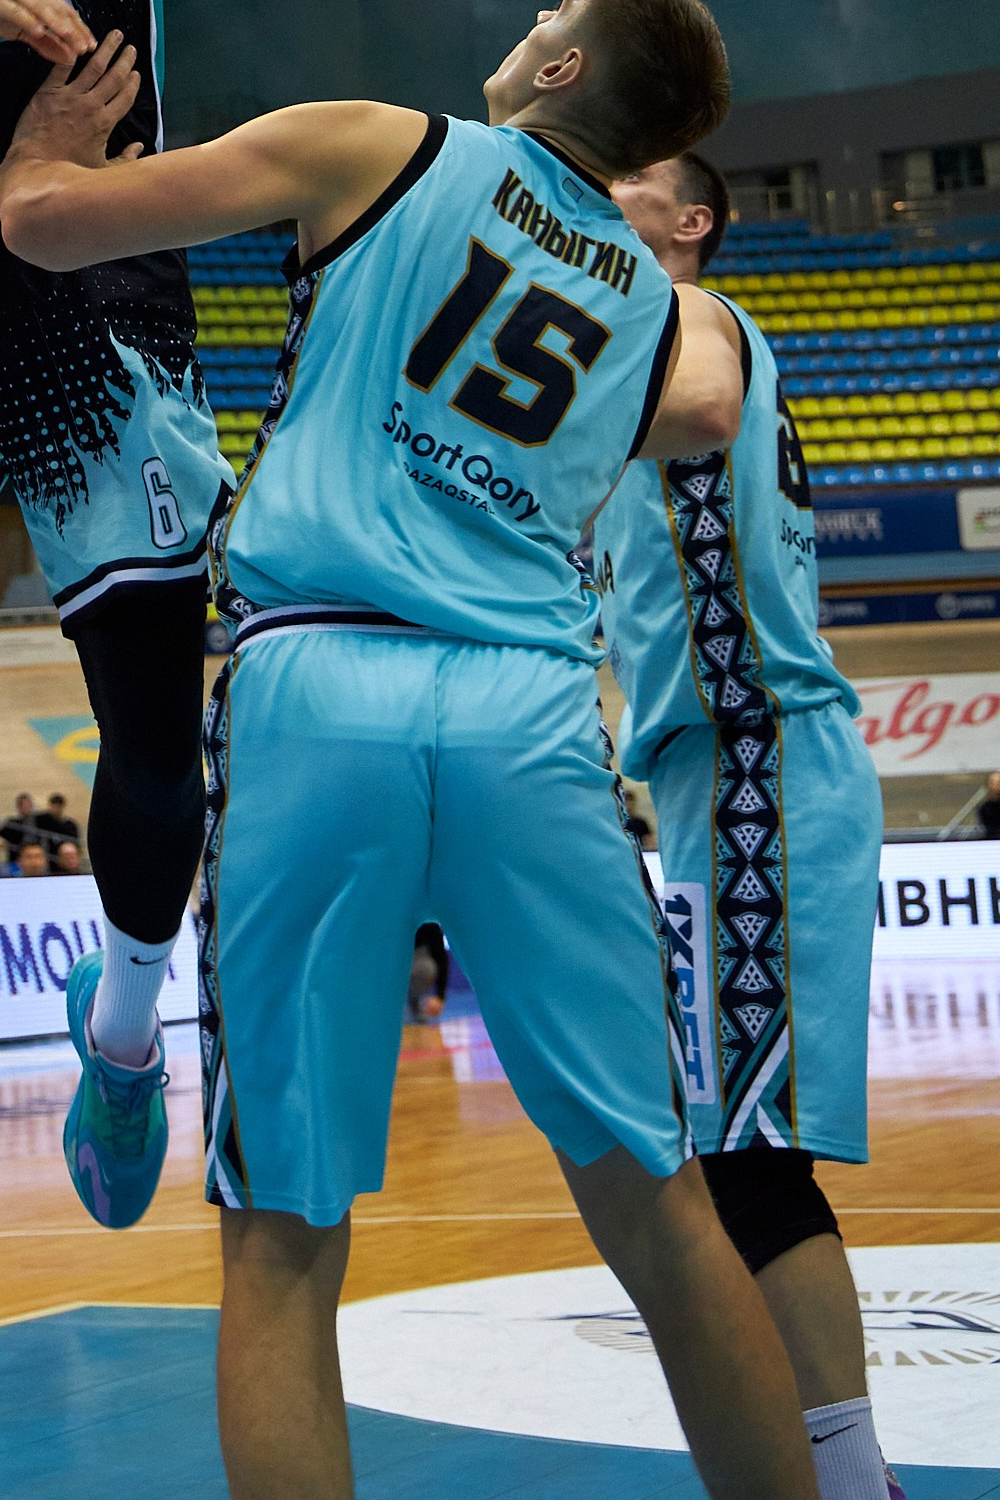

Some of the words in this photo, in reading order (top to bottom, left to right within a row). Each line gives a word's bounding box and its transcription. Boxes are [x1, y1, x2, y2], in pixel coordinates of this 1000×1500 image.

[490, 166, 638, 298] КАНЫГИН
[401, 234, 613, 448] 15
[141, 456, 188, 549] 6
[382, 401, 540, 522] SportQory
[403, 462, 496, 515] AZAQSTA
[853, 678, 1000, 760] algo
